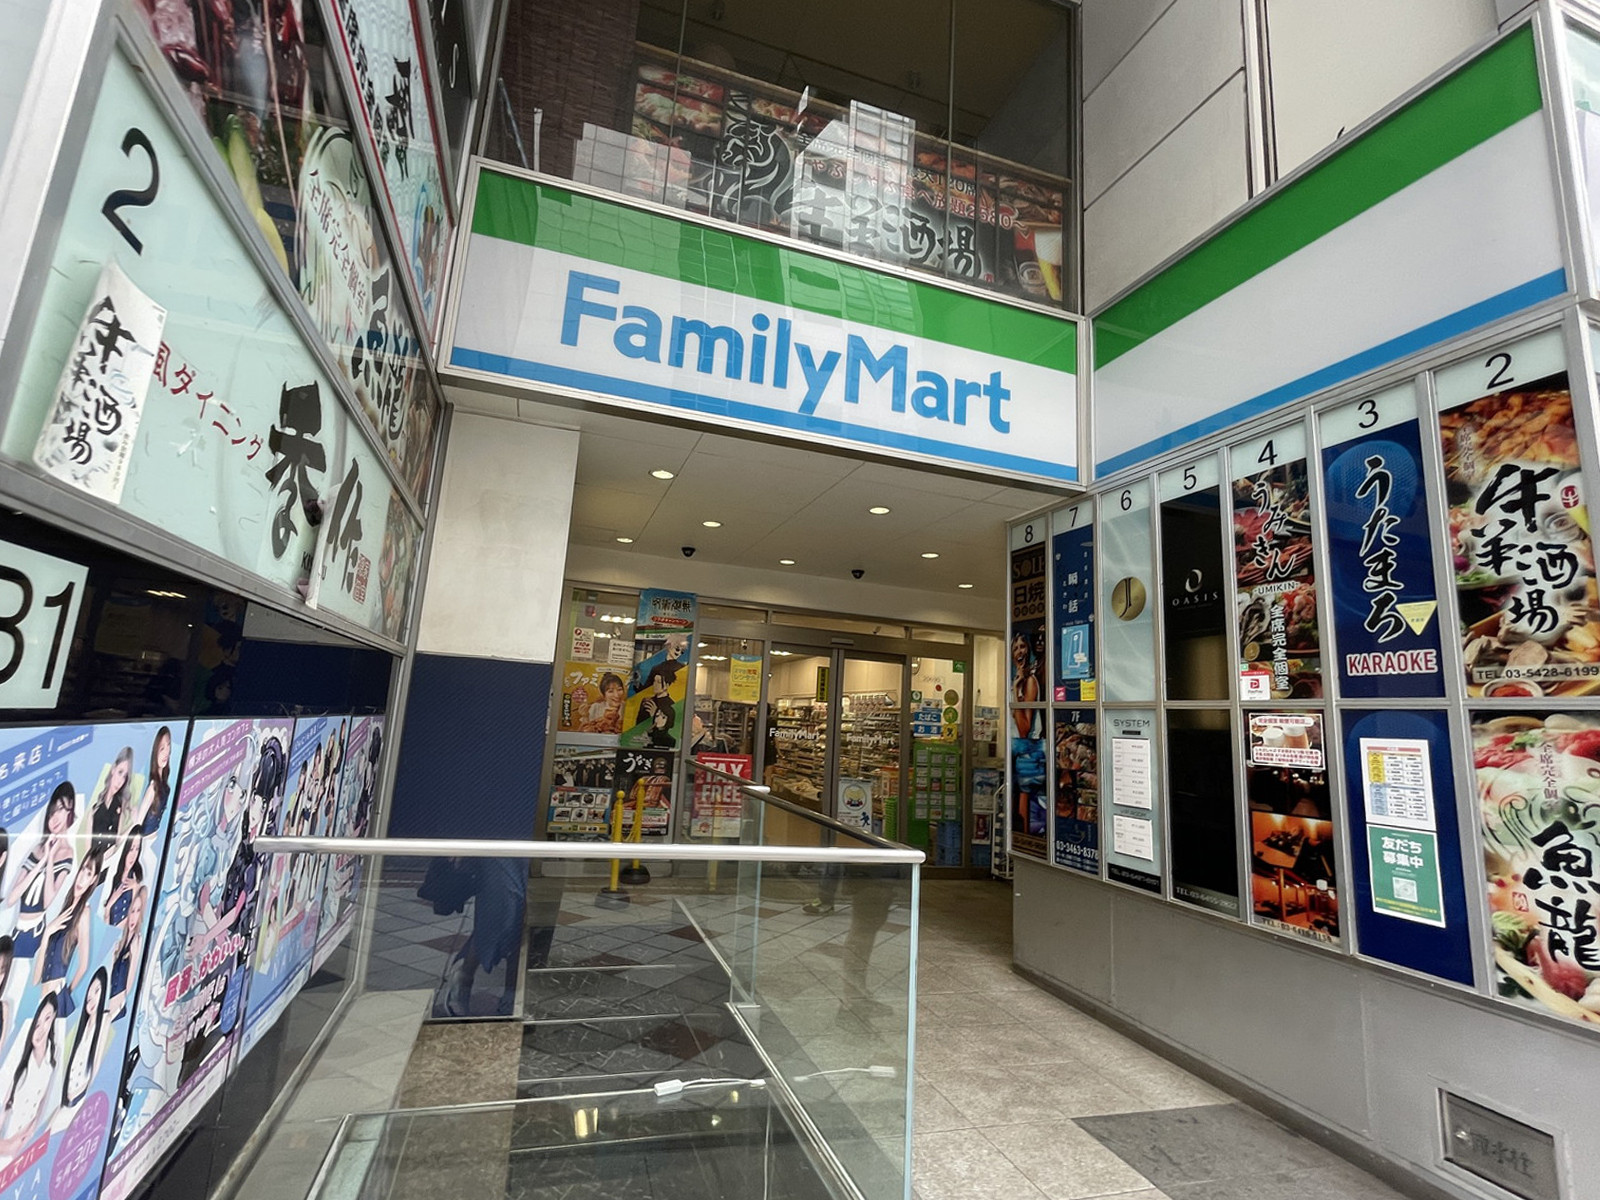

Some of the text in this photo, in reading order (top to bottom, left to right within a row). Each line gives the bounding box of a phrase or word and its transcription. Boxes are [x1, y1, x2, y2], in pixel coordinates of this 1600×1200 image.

[101, 127, 160, 256] 2
[560, 270, 1011, 434] FamilyMart
[1484, 352, 1514, 389] 2
[1357, 400, 1379, 428] 3
[1257, 440, 1278, 465] 4
[1183, 466, 1197, 490] 5
[1120, 490, 1132, 511] 6
[1069, 507, 1079, 527] 7
[1024, 525, 1034, 543] 8
[1355, 456, 1405, 643] うたまろ
[1172, 591, 1218, 607] OASIS
[1347, 651, 1438, 676] KARAOKE
[1113, 719, 1150, 728] SYSTEM
[769, 727, 819, 742] FamilyMart
[846, 733, 895, 745] FamilyMart
[623, 752, 653, 773] うなぎ
[1381, 836, 1422, 854] 友だち
[1382, 851, 1424, 869] 募集中
